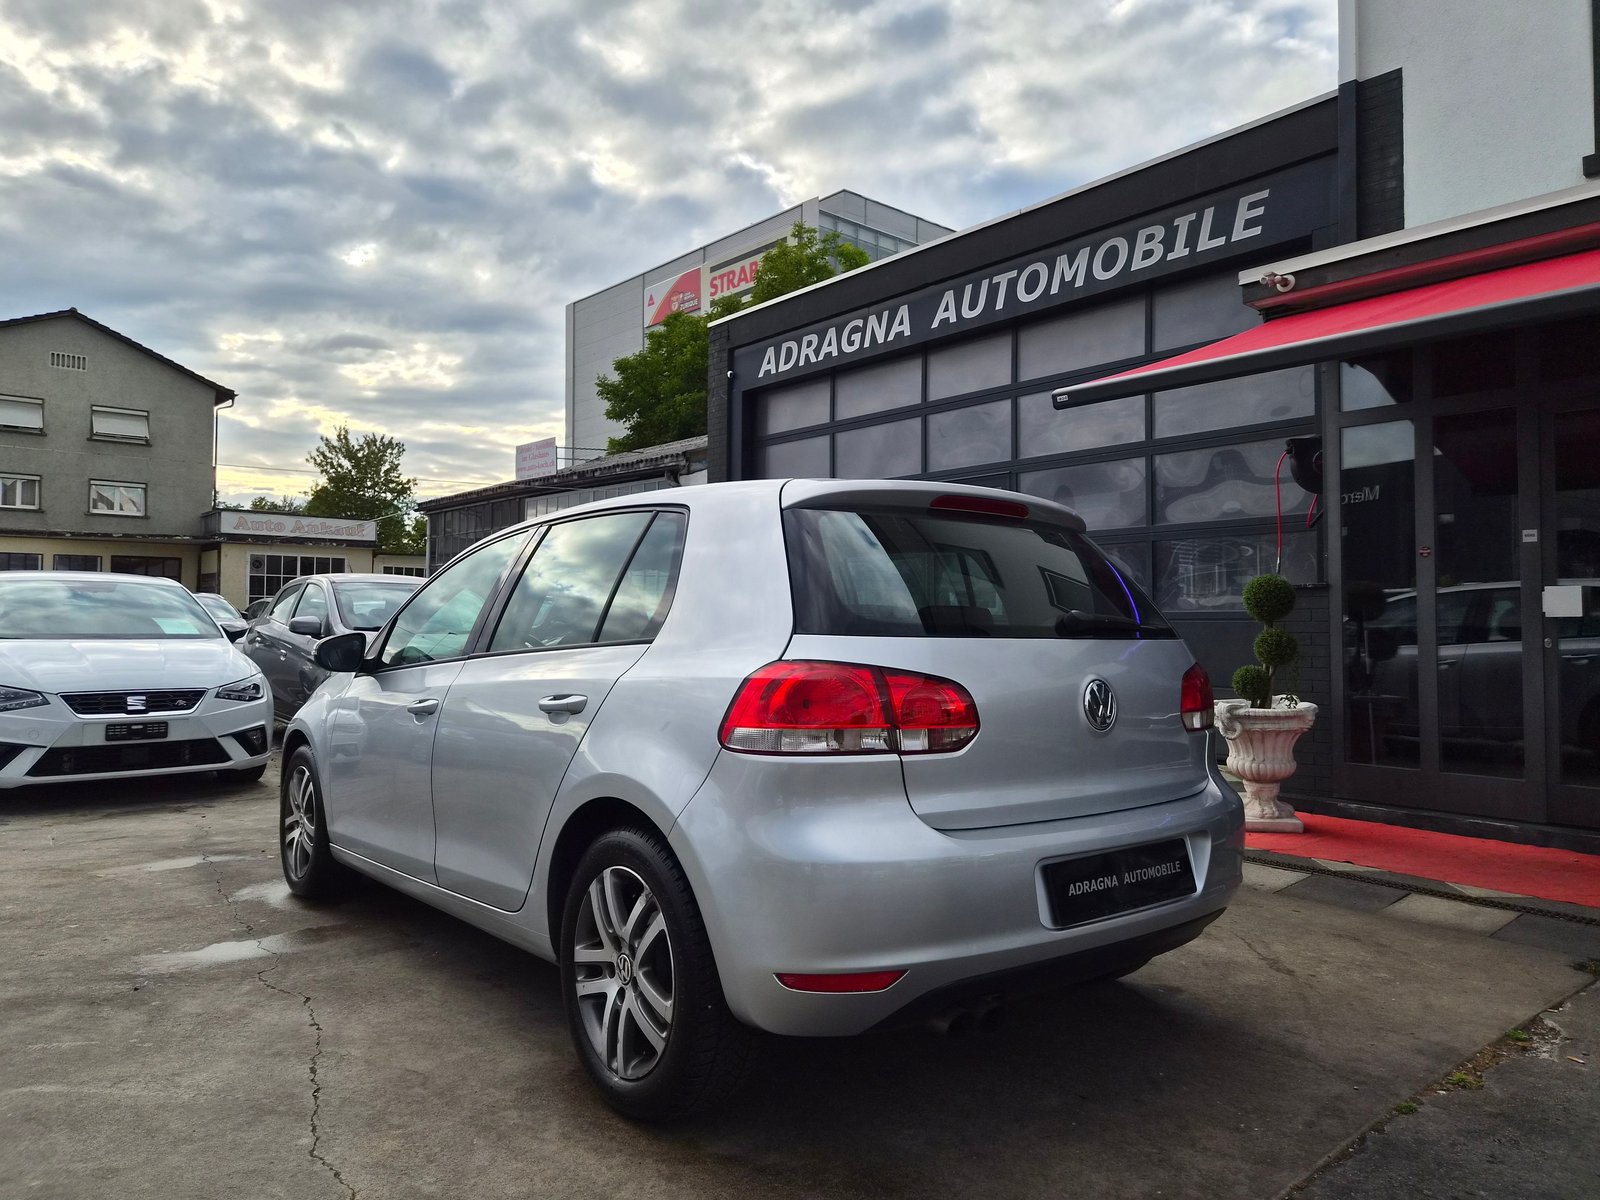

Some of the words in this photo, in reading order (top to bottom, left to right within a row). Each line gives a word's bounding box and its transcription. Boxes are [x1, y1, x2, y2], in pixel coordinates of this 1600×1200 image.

[758, 304, 911, 378] ADRAGNA
[931, 189, 1270, 329] AUTOMOBILE
[233, 516, 285, 532] Auto
[290, 520, 365, 537] Ankauf
[1068, 875, 1119, 897] ADRAGNA
[1123, 860, 1181, 885] AUTOMOBILE
